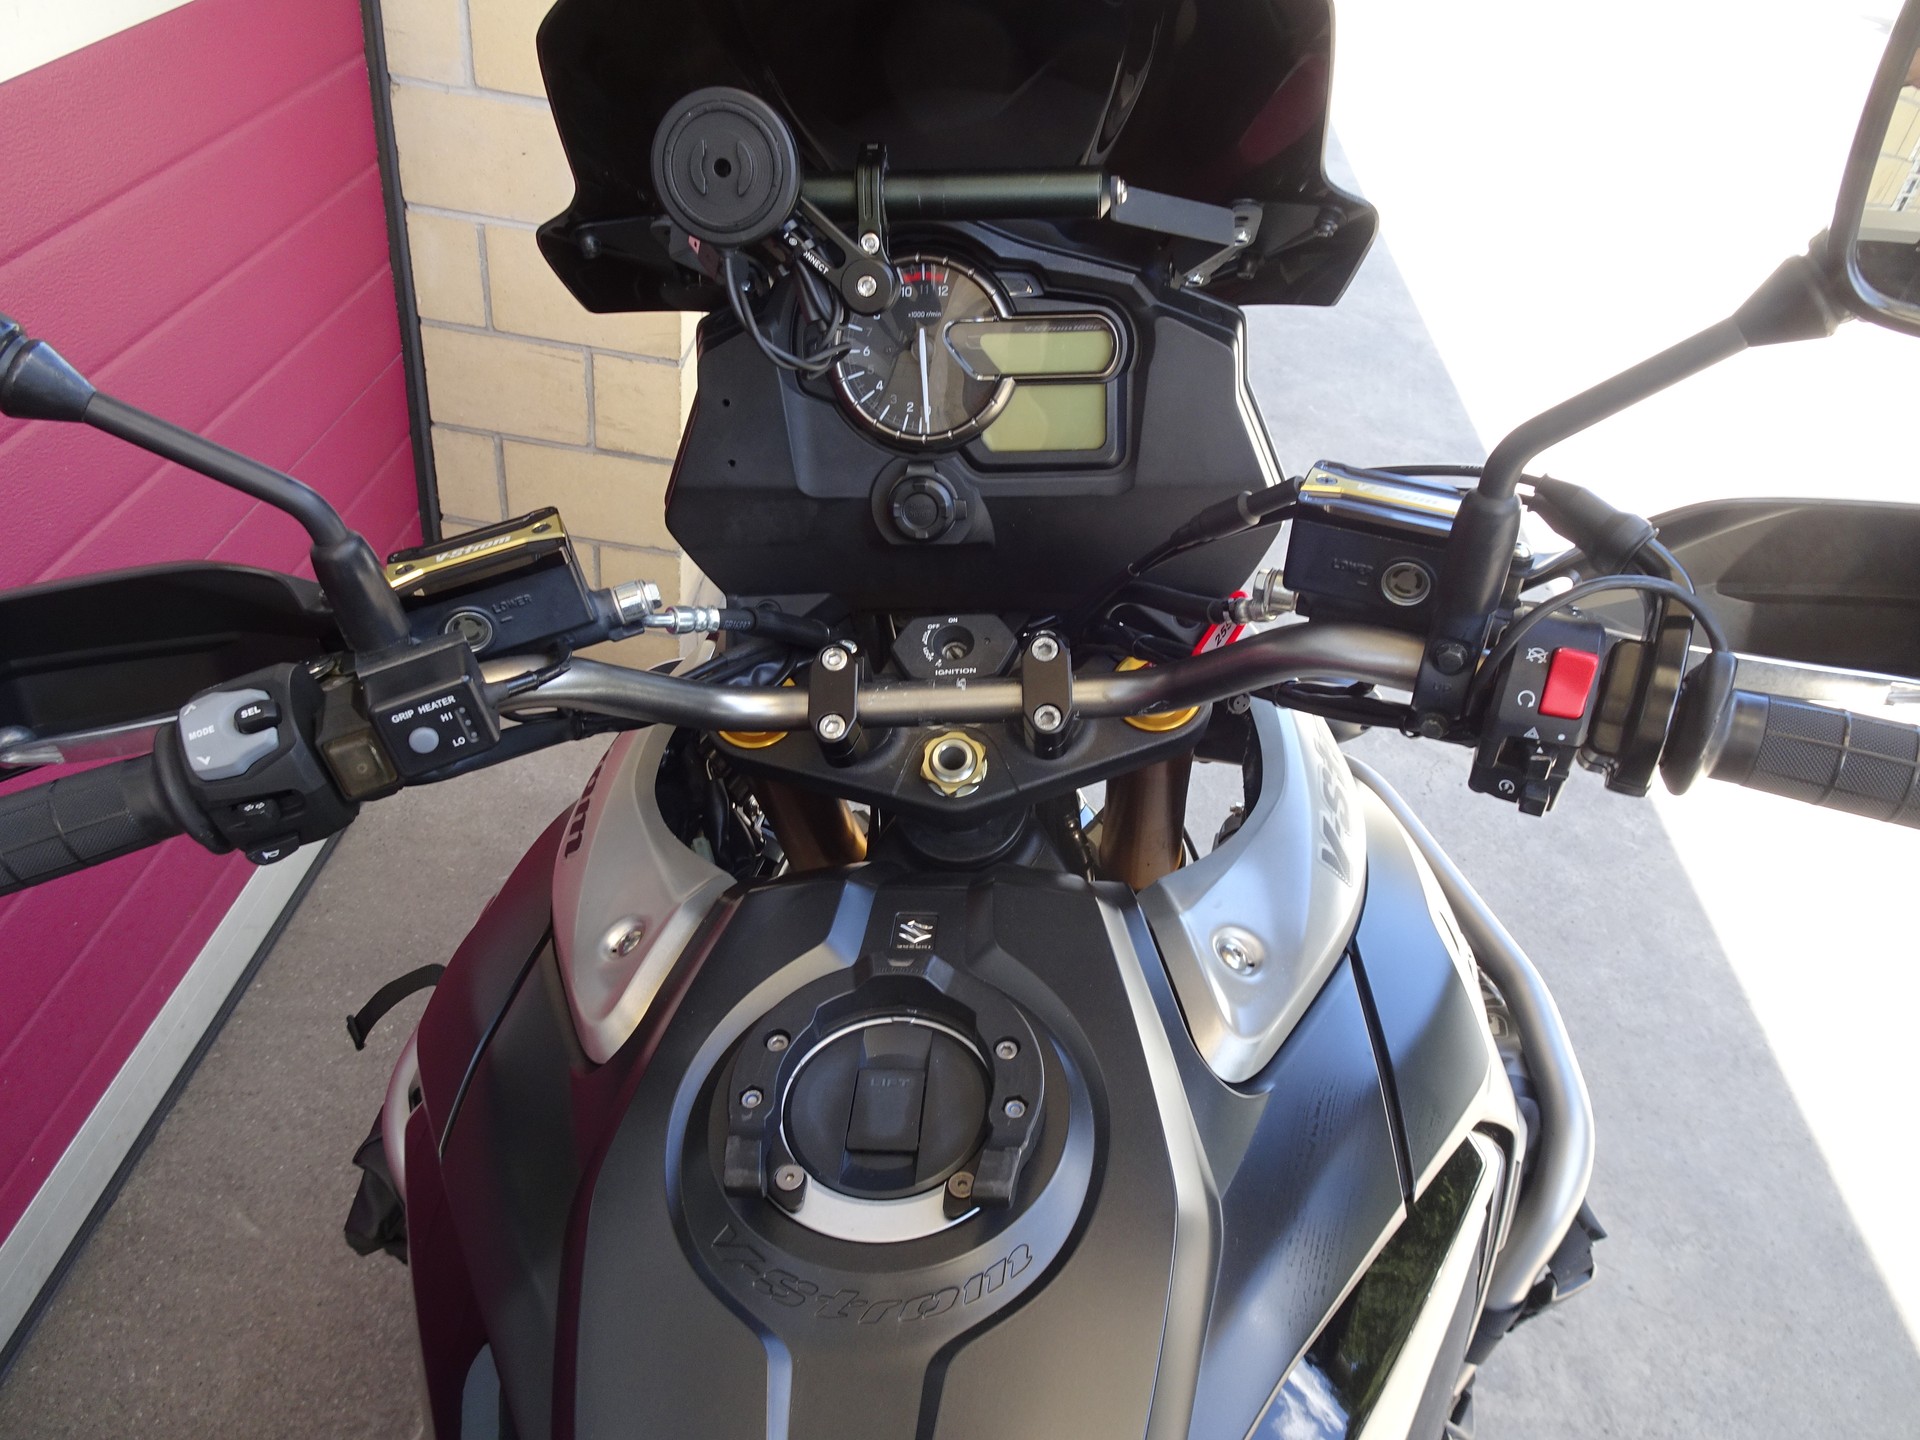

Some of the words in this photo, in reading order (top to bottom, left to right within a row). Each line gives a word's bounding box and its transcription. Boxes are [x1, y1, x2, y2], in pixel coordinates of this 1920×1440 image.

[901, 286, 913, 298] 10
[938, 285, 949, 297] 12
[863, 345, 871, 357] 6
[875, 380, 884, 391] 4
[906, 401, 914, 412] 2
[492, 593, 532, 615] LOWER
[935, 668, 976, 676] IGNITION
[240, 705, 261, 719] SEL
[391, 709, 415, 724] GRIP
[417, 695, 457, 715] HEATER
[440, 711, 453, 722] HI
[188, 724, 215, 741] MODE
[452, 736, 466, 748] LO
